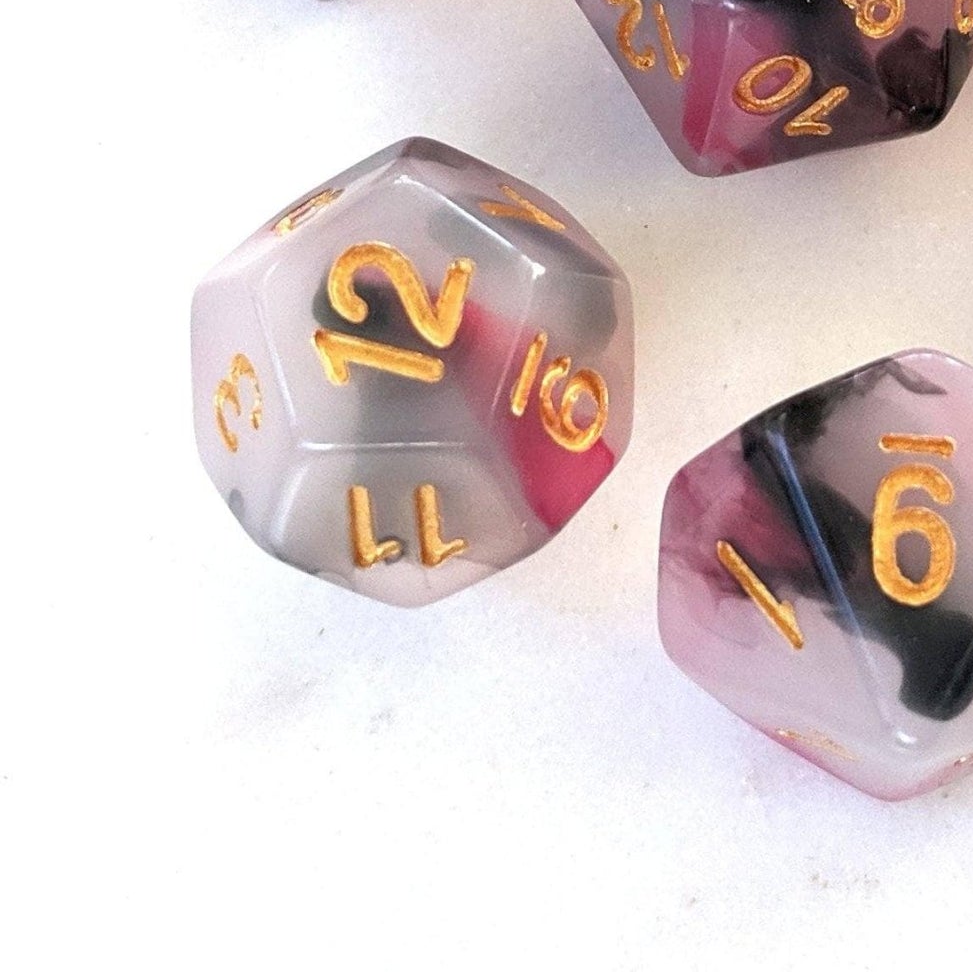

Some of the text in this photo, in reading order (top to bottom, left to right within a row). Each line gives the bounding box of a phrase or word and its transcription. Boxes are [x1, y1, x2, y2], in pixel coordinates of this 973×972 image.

[732, 55, 850, 136] 10
[312, 239, 477, 386] 12
[213, 353, 263, 453] 3
[347, 483, 470, 570] 11
[715, 539, 804, 651] 1
